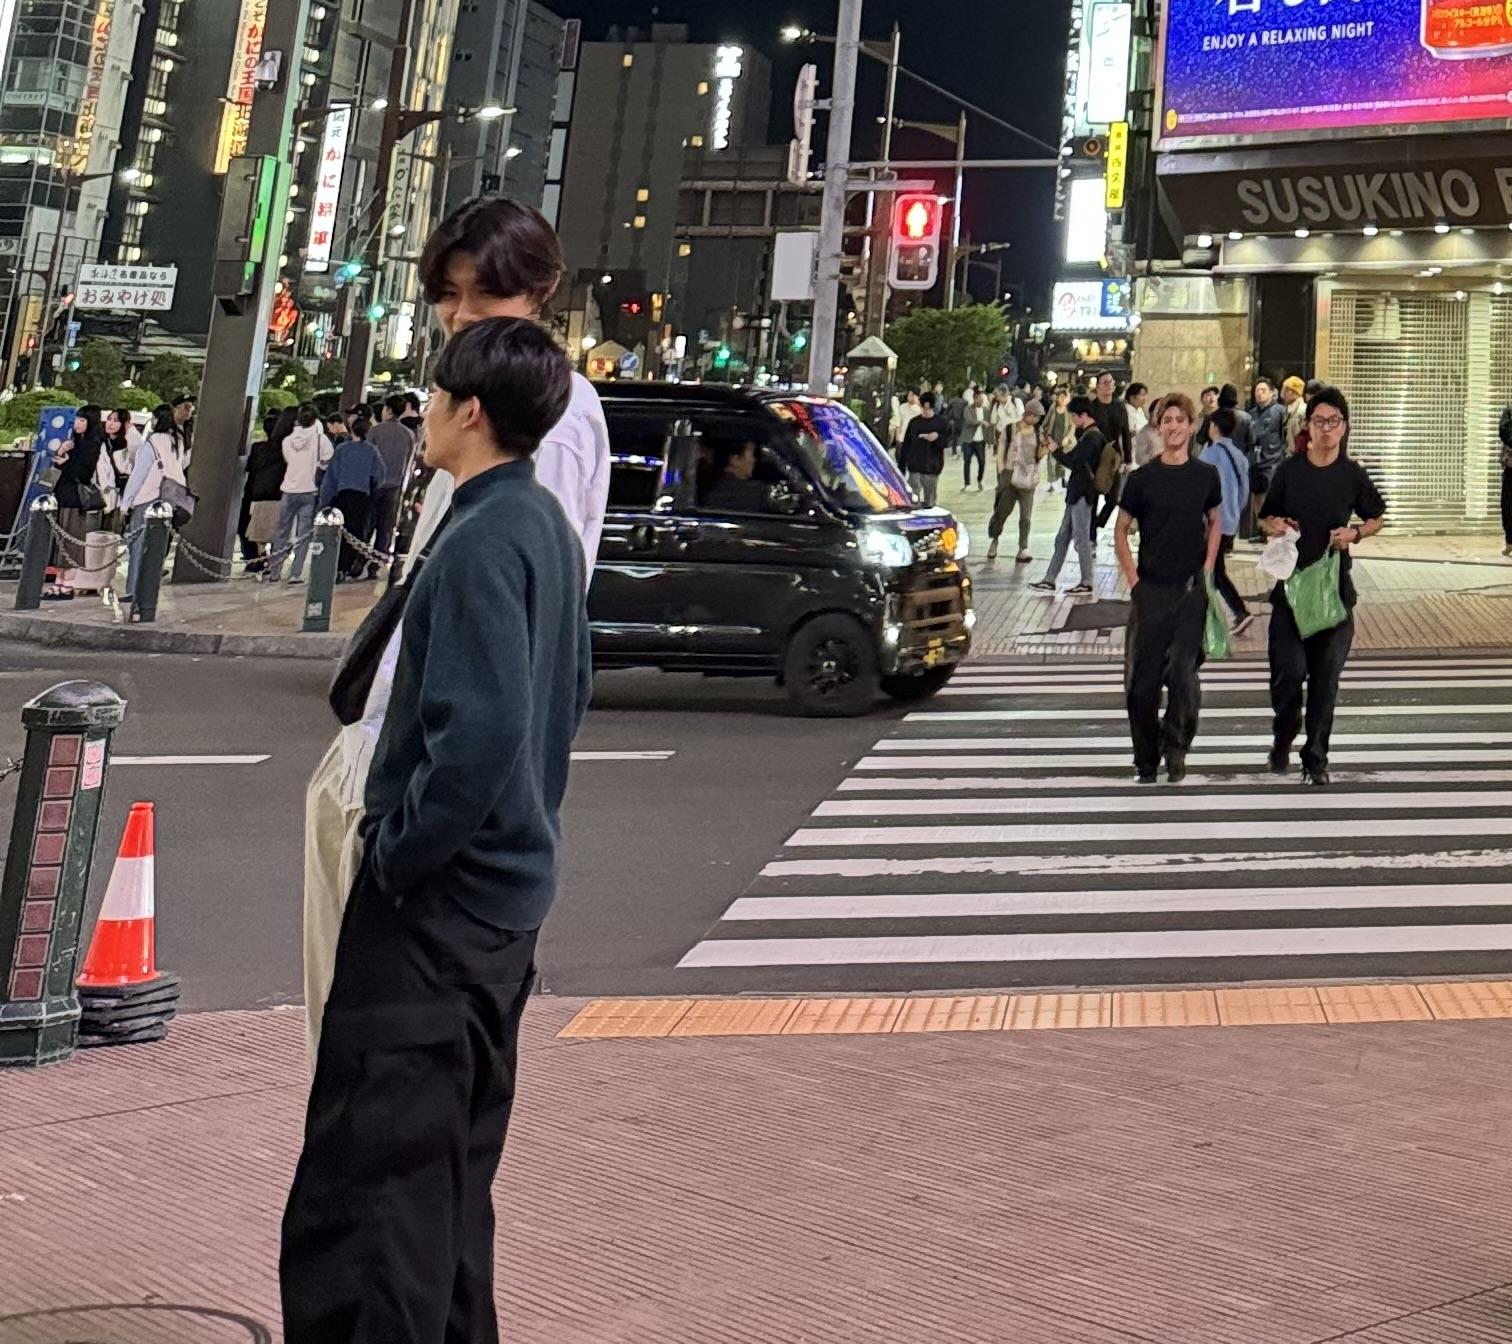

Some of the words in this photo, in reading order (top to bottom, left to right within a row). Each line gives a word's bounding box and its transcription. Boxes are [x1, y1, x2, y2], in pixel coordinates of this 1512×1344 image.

[1202, 32, 1245, 51] ENJOY
[1247, 32, 1258, 47] A
[1261, 25, 1327, 45] RELAXING
[1331, 21, 1375, 39] NIGHT
[1237, 167, 1479, 225] SUSUKINO
[82, 288, 167, 306] おみやげ処
